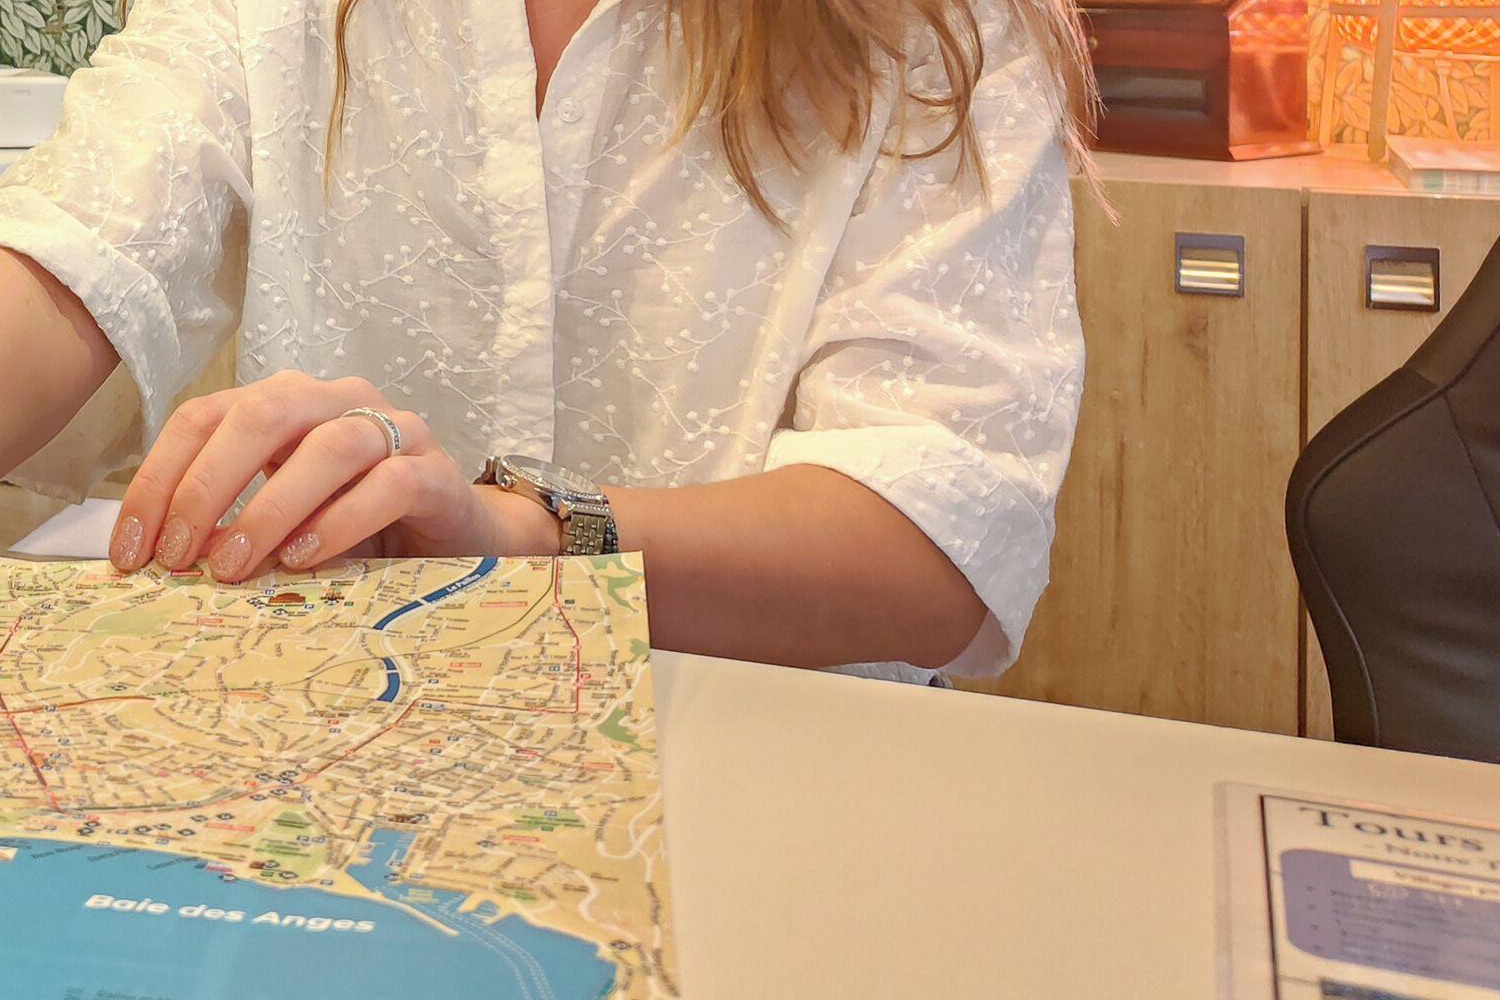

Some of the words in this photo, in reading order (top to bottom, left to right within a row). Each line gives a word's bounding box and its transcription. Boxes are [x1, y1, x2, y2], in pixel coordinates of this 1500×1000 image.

[84, 894, 171, 914] Baie
[178, 904, 246, 922] des
[250, 911, 377, 933] Anges
